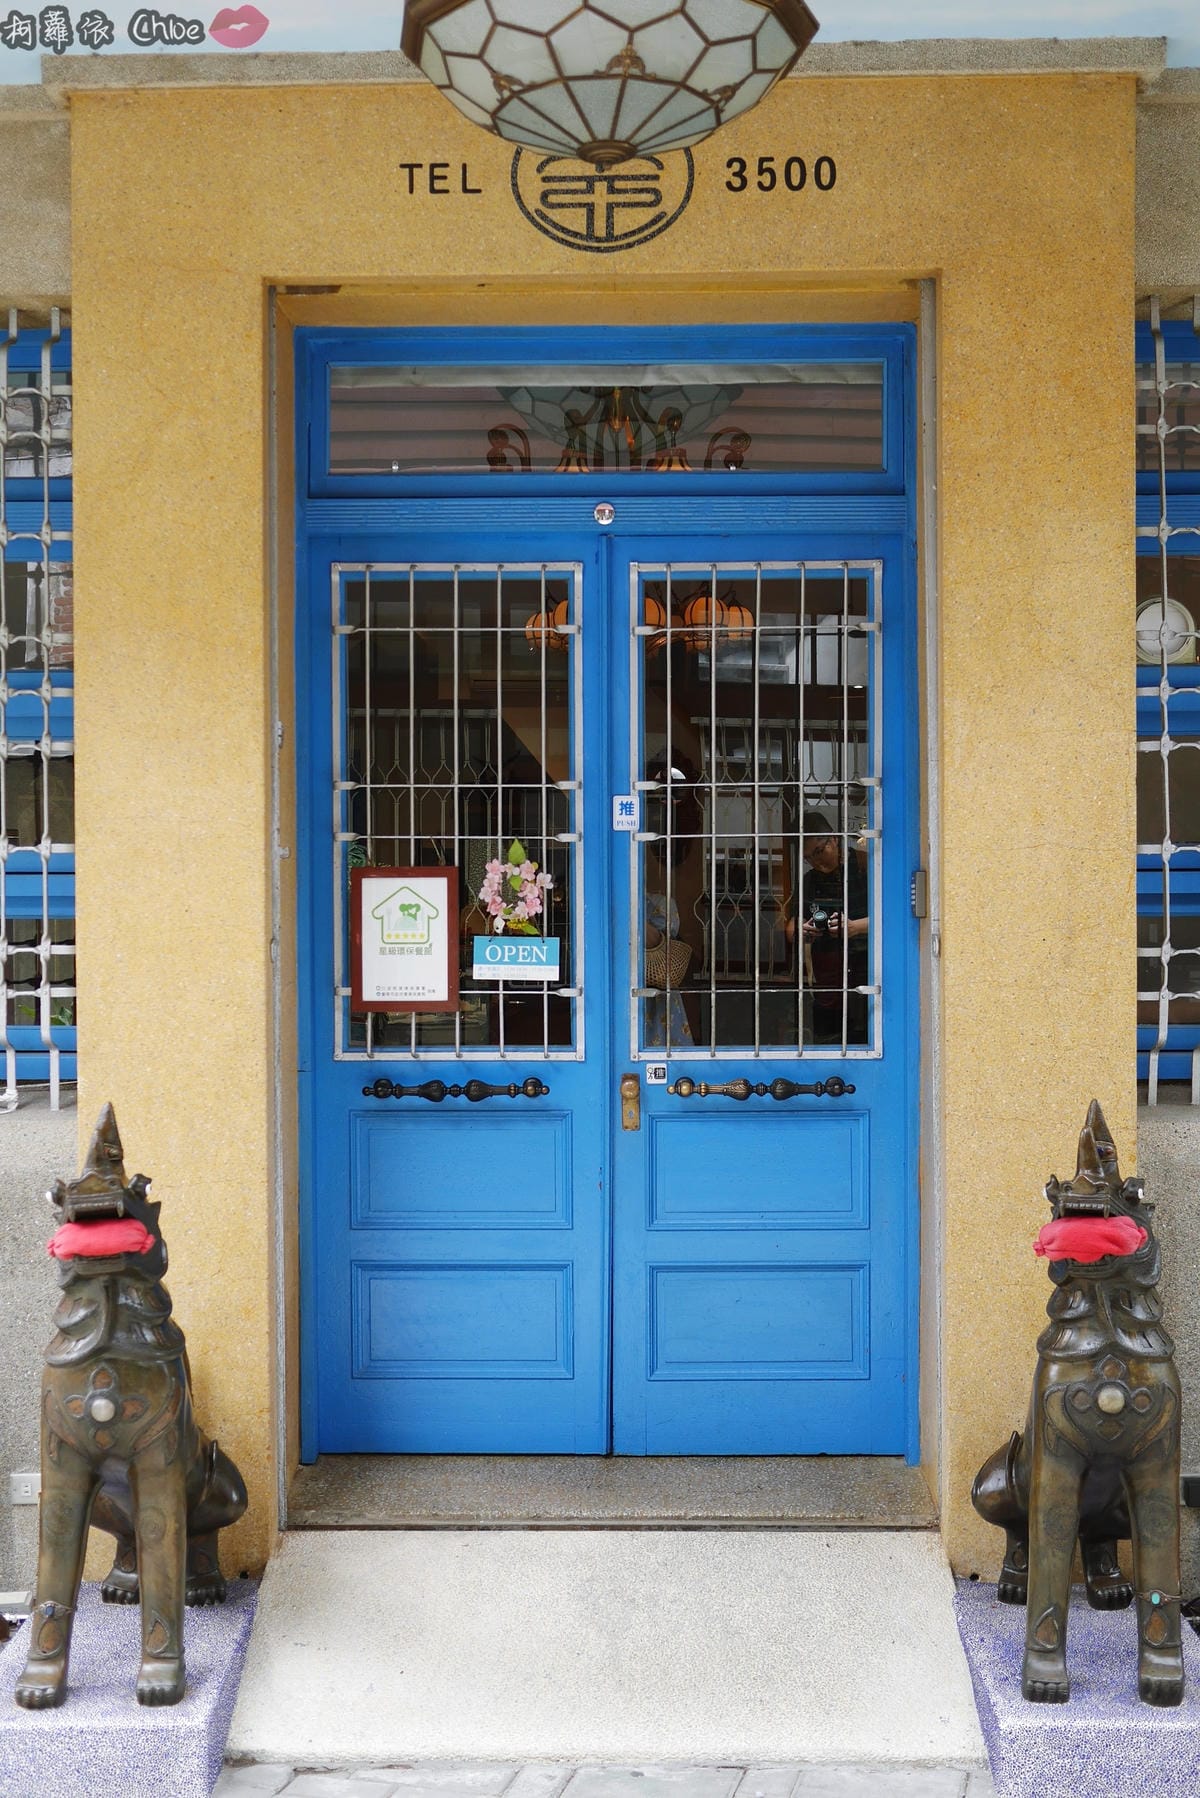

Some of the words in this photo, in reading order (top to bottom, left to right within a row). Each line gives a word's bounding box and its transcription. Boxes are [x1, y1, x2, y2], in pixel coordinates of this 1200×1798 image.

[399, 162, 482, 195] TEL
[725, 156, 837, 192] 3500
[618, 800, 635, 816] 推
[485, 944, 548, 963] OPEN
